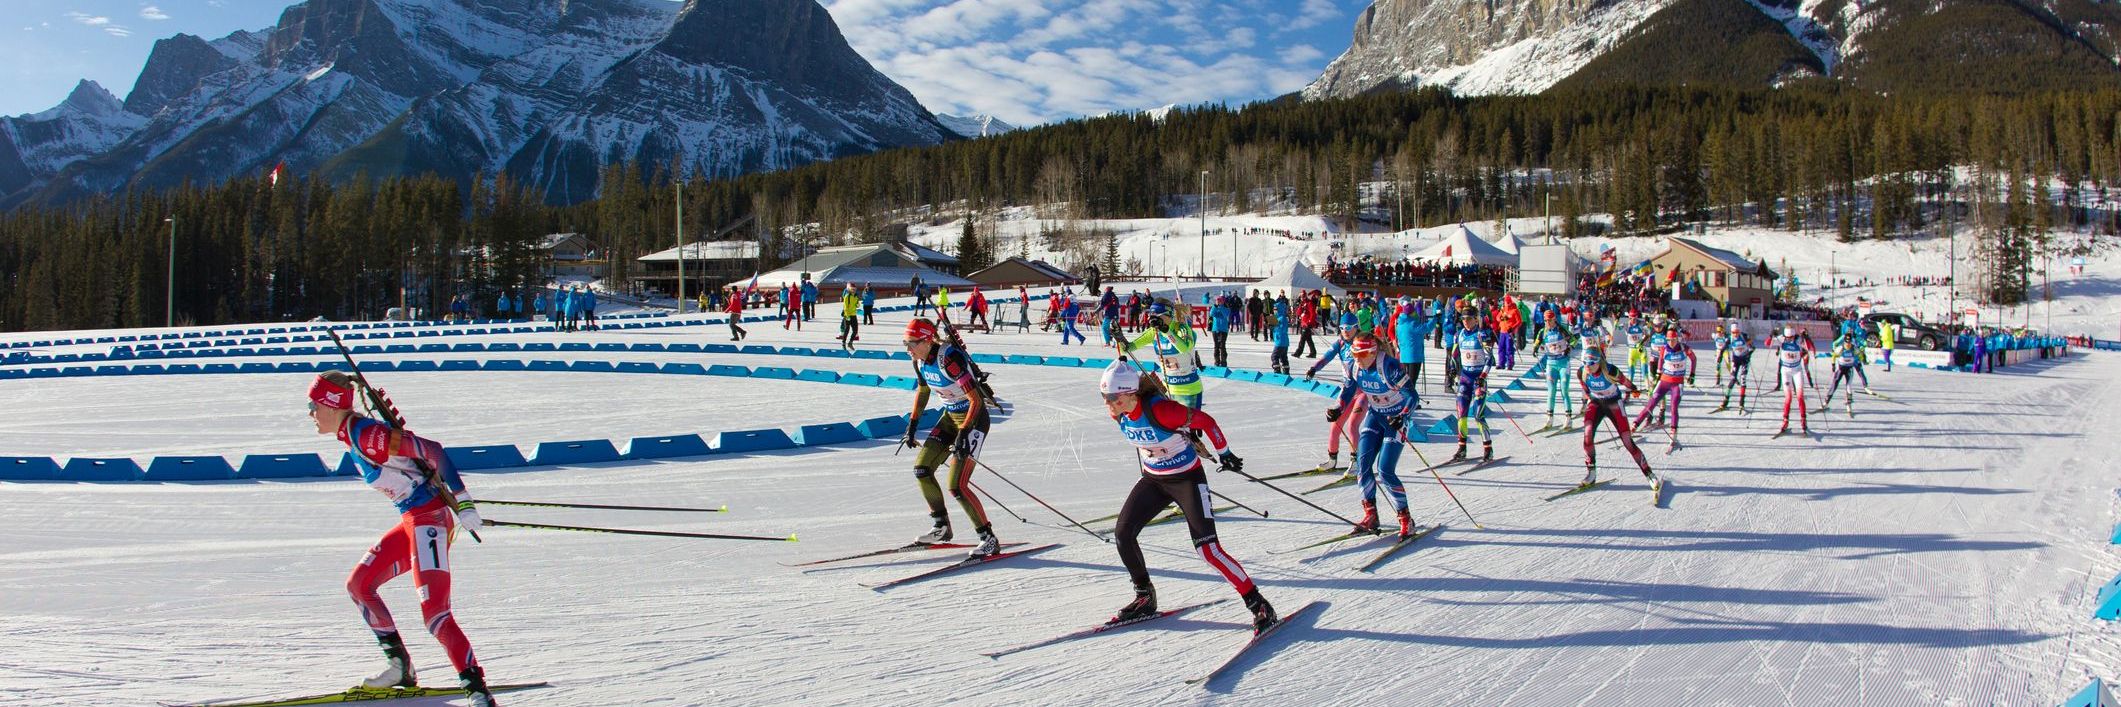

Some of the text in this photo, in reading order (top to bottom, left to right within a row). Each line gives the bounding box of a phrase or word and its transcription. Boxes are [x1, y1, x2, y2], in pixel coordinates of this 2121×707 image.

[924, 370, 941, 382] DKB
[1361, 380, 1380, 390] DKB
[1127, 429, 1155, 440] DKB
[429, 539, 440, 569] 1
[343, 690, 426, 702] FISCHER
